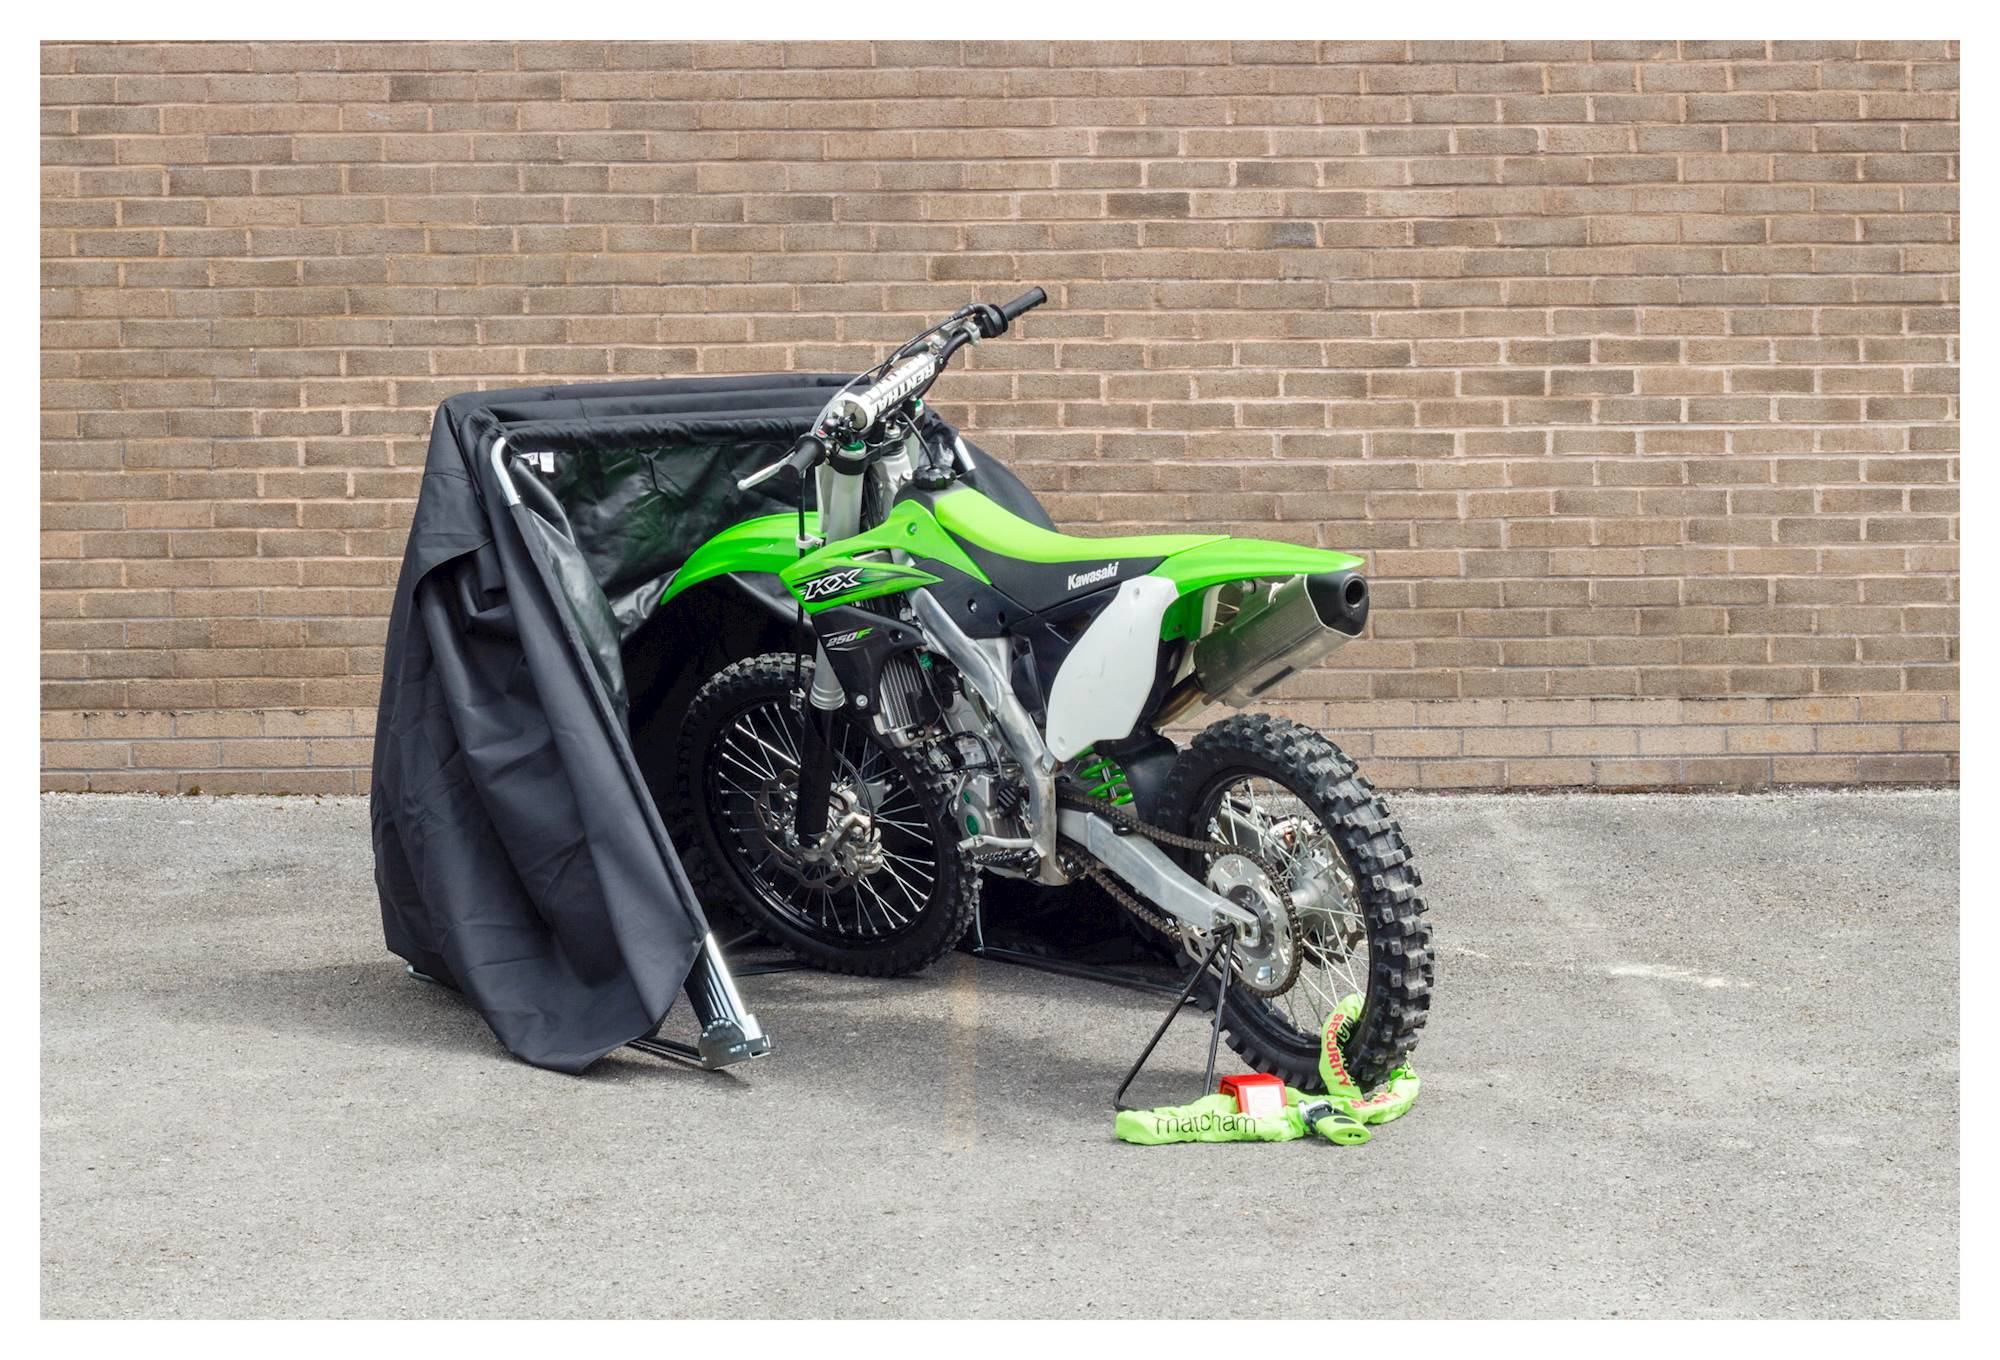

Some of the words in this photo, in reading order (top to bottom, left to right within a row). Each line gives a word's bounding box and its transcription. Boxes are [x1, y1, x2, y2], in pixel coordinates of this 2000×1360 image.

[804, 568, 864, 601] KX
[1067, 561, 1119, 591] Kawasaki
[825, 627, 874, 648] 250F
[1326, 1013, 1351, 1087] SECURITY
